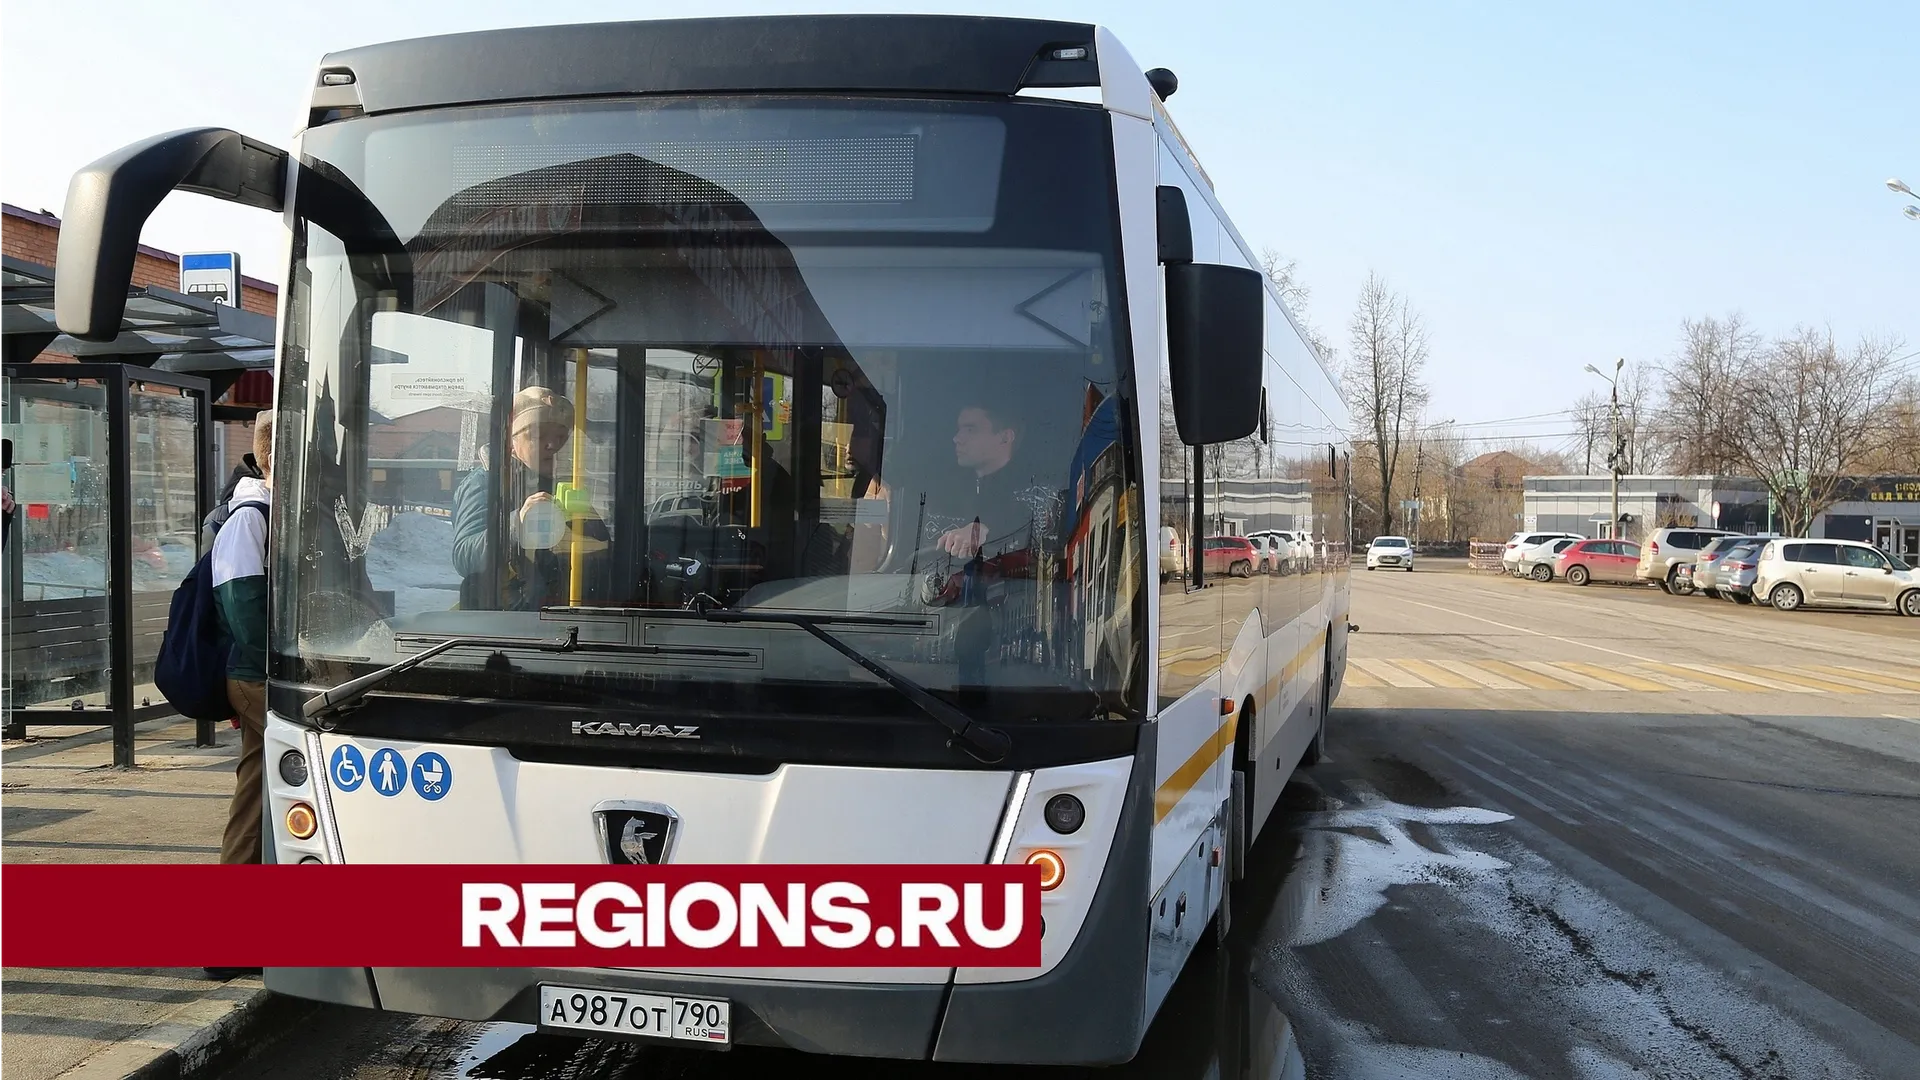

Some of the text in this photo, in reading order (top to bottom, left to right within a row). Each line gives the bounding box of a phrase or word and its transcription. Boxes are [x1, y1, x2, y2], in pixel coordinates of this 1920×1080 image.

[659, 141, 787, 168] Вокзал
[571, 721, 701, 739] KAMAZ
[674, 1001, 720, 1028] 790
[685, 1027, 708, 1038] RUS
